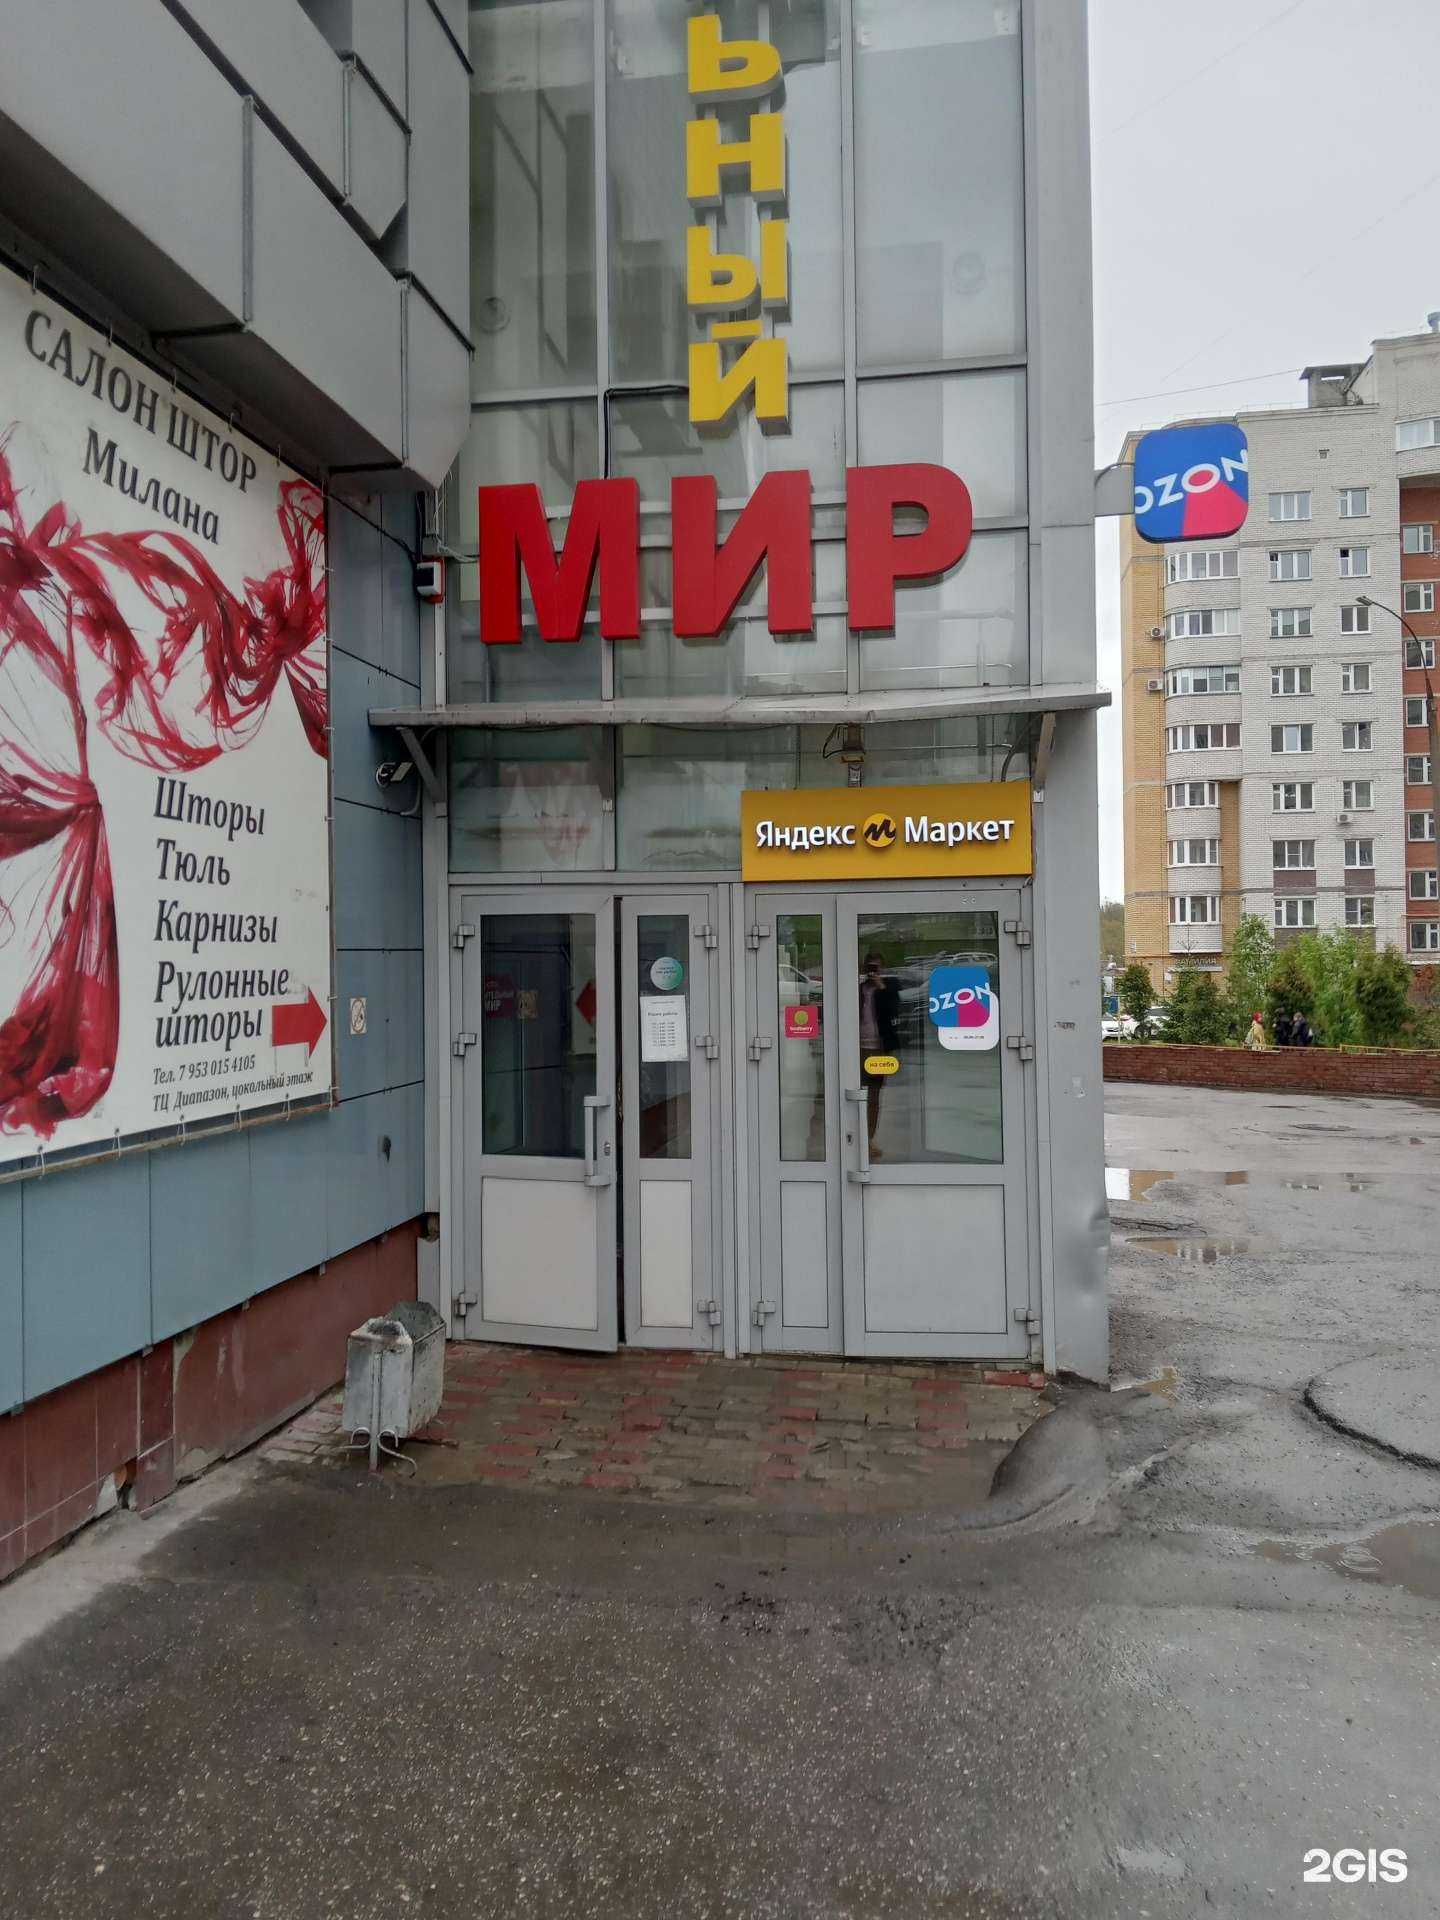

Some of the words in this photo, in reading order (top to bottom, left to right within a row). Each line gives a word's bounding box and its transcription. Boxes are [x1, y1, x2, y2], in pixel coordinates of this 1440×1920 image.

[24, 308, 158, 435] САЛОН
[167, 404, 258, 494] ШТОР
[81, 427, 220, 546] Милана
[1135, 448, 1249, 514] OZON
[478, 462, 973, 645] МИР
[153, 776, 265, 842] Шторы
[755, 820, 856, 850] Яндекс
[904, 815, 1015, 848] Маркет
[156, 837, 231, 886] Тюль
[153, 899, 278, 954] Карнизы
[153, 960, 290, 1014] Рулонные
[929, 982, 991, 1014] OZON
[155, 1008, 263, 1051] шторы
[153, 1067, 175, 1085] Тел.
[179, 1064, 186, 1081] 7
[188, 1060, 208, 1080] 953
[210, 1057, 229, 1076] 015
[231, 1054, 256, 1072] 4105
[153, 1091, 169, 1112] ТЦ
[173, 1086, 230, 1112] Диапазон,
[231, 1071, 285, 1100] цокольный
[285, 1071, 314, 1087] этаж
